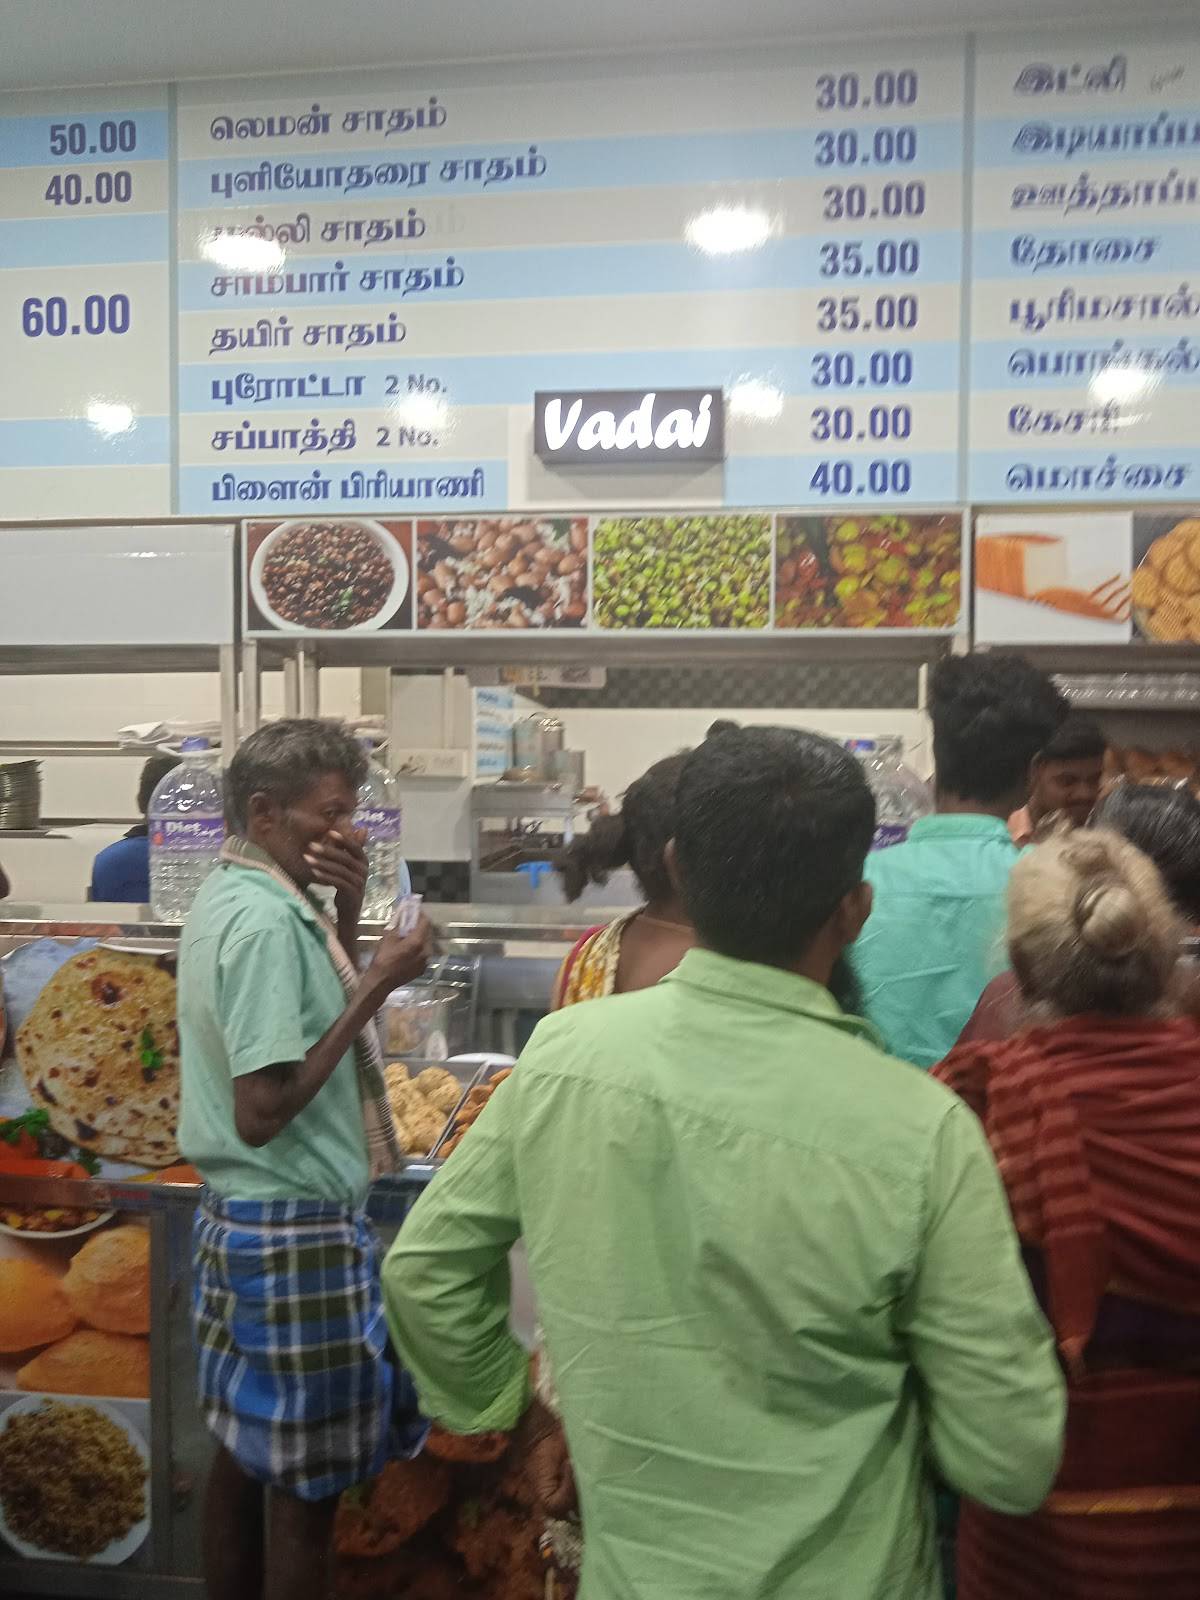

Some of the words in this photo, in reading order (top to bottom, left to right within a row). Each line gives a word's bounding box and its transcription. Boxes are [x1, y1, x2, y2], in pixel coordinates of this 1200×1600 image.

[815, 69, 917, 111] 30.00
[210, 103, 332, 140] லெமன்
[342, 96, 447, 137] சாதம்
[50, 120, 136, 156] 50.00
[814, 127, 916, 167] 30.00
[45, 171, 132, 205] 40.00
[211, 161, 430, 198] புளியோதரை
[439, 145, 547, 188] சாதம்
[823, 179, 925, 222] 30.00
[321, 208, 426, 247] சாதம்
[359, 256, 464, 296] சாதம்
[819, 239, 919, 278] 35.00
[22, 294, 130, 338] 60.00
[817, 294, 918, 331] 35.00
[208, 316, 294, 355] தயிர்
[303, 312, 406, 351] சாதம்
[811, 351, 912, 387] 30.00
[212, 373, 366, 405] புரோட்டா
[385, 375, 399, 395] 2
[211, 418, 356, 455] சப்பாத்தி
[376, 427, 390, 447] 2
[544, 393, 712, 450] Vadai
[811, 404, 911, 440] 30.00
[212, 470, 331, 501] பிளைன்
[340, 468, 484, 498] பிரியாணி
[809, 460, 911, 495] 40.00
